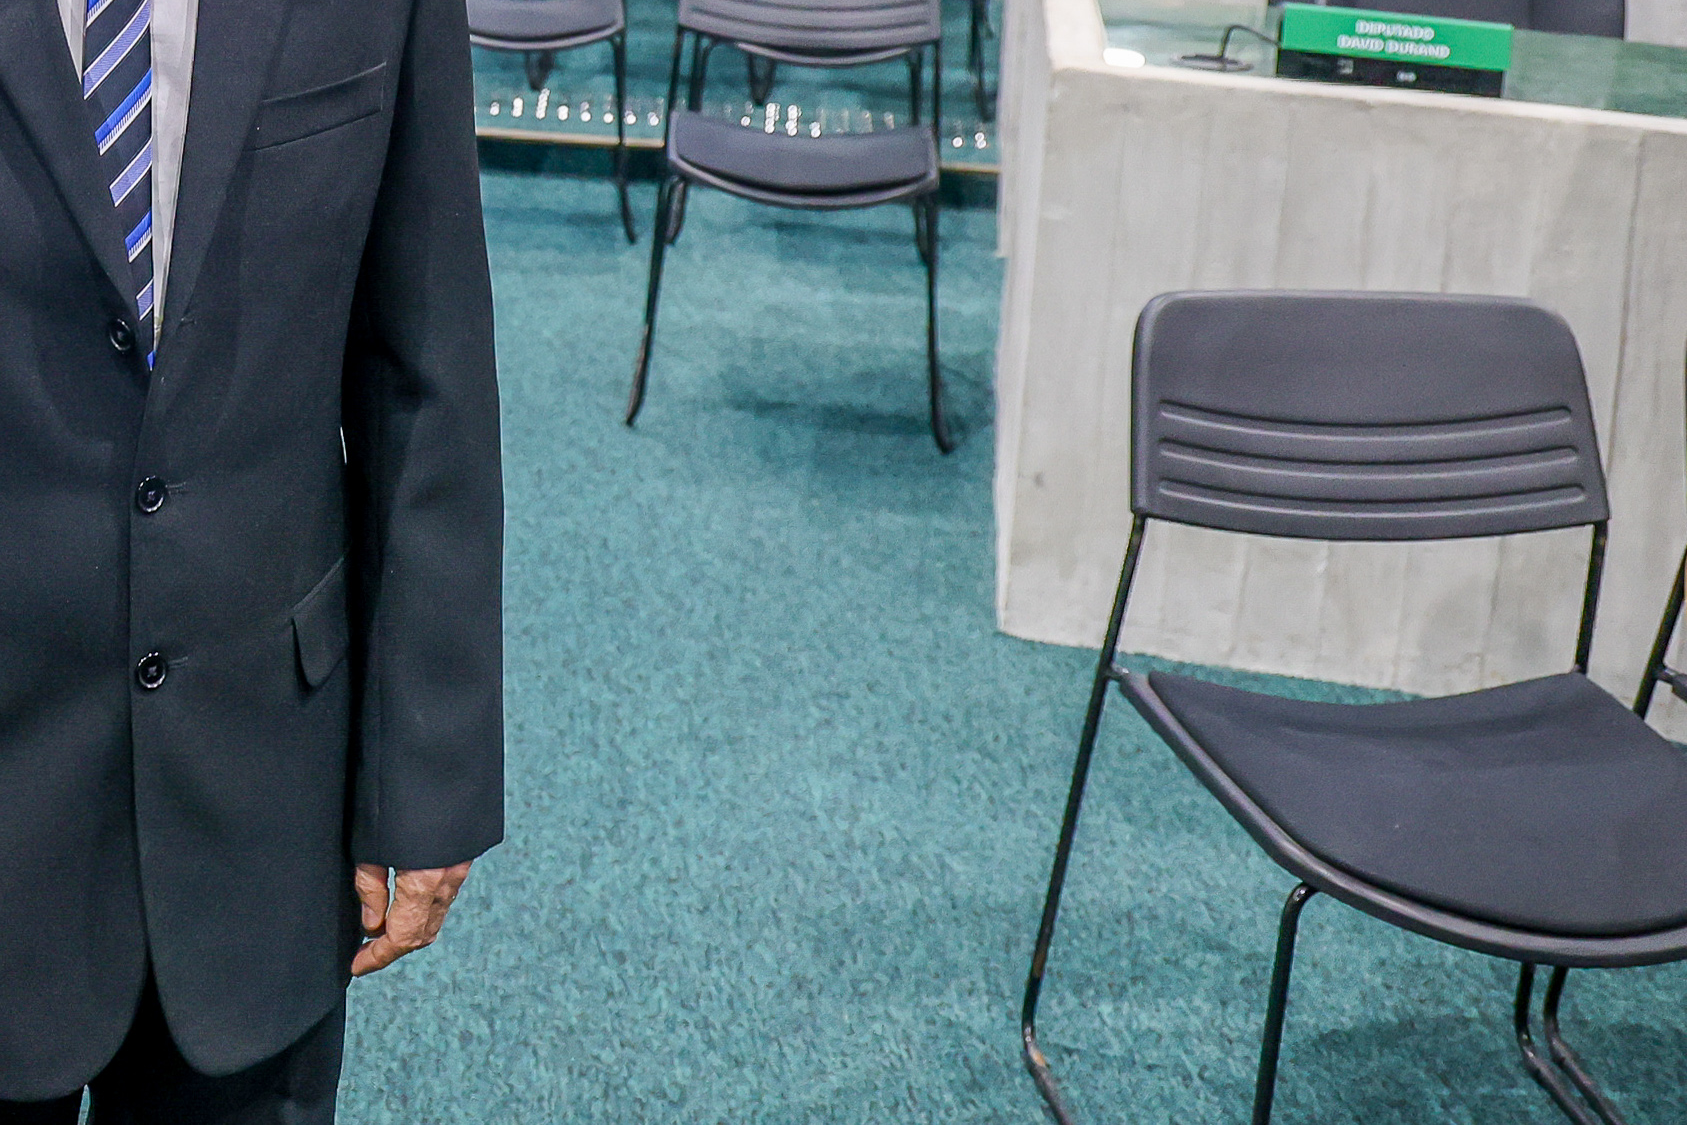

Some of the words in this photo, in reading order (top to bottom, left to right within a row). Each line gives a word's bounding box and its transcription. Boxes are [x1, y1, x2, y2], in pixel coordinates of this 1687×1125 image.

[1355, 19, 1435, 41] DEPUTADO
[1337, 34, 1385, 53] DAVID
[1385, 39, 1451, 59] DURAND
